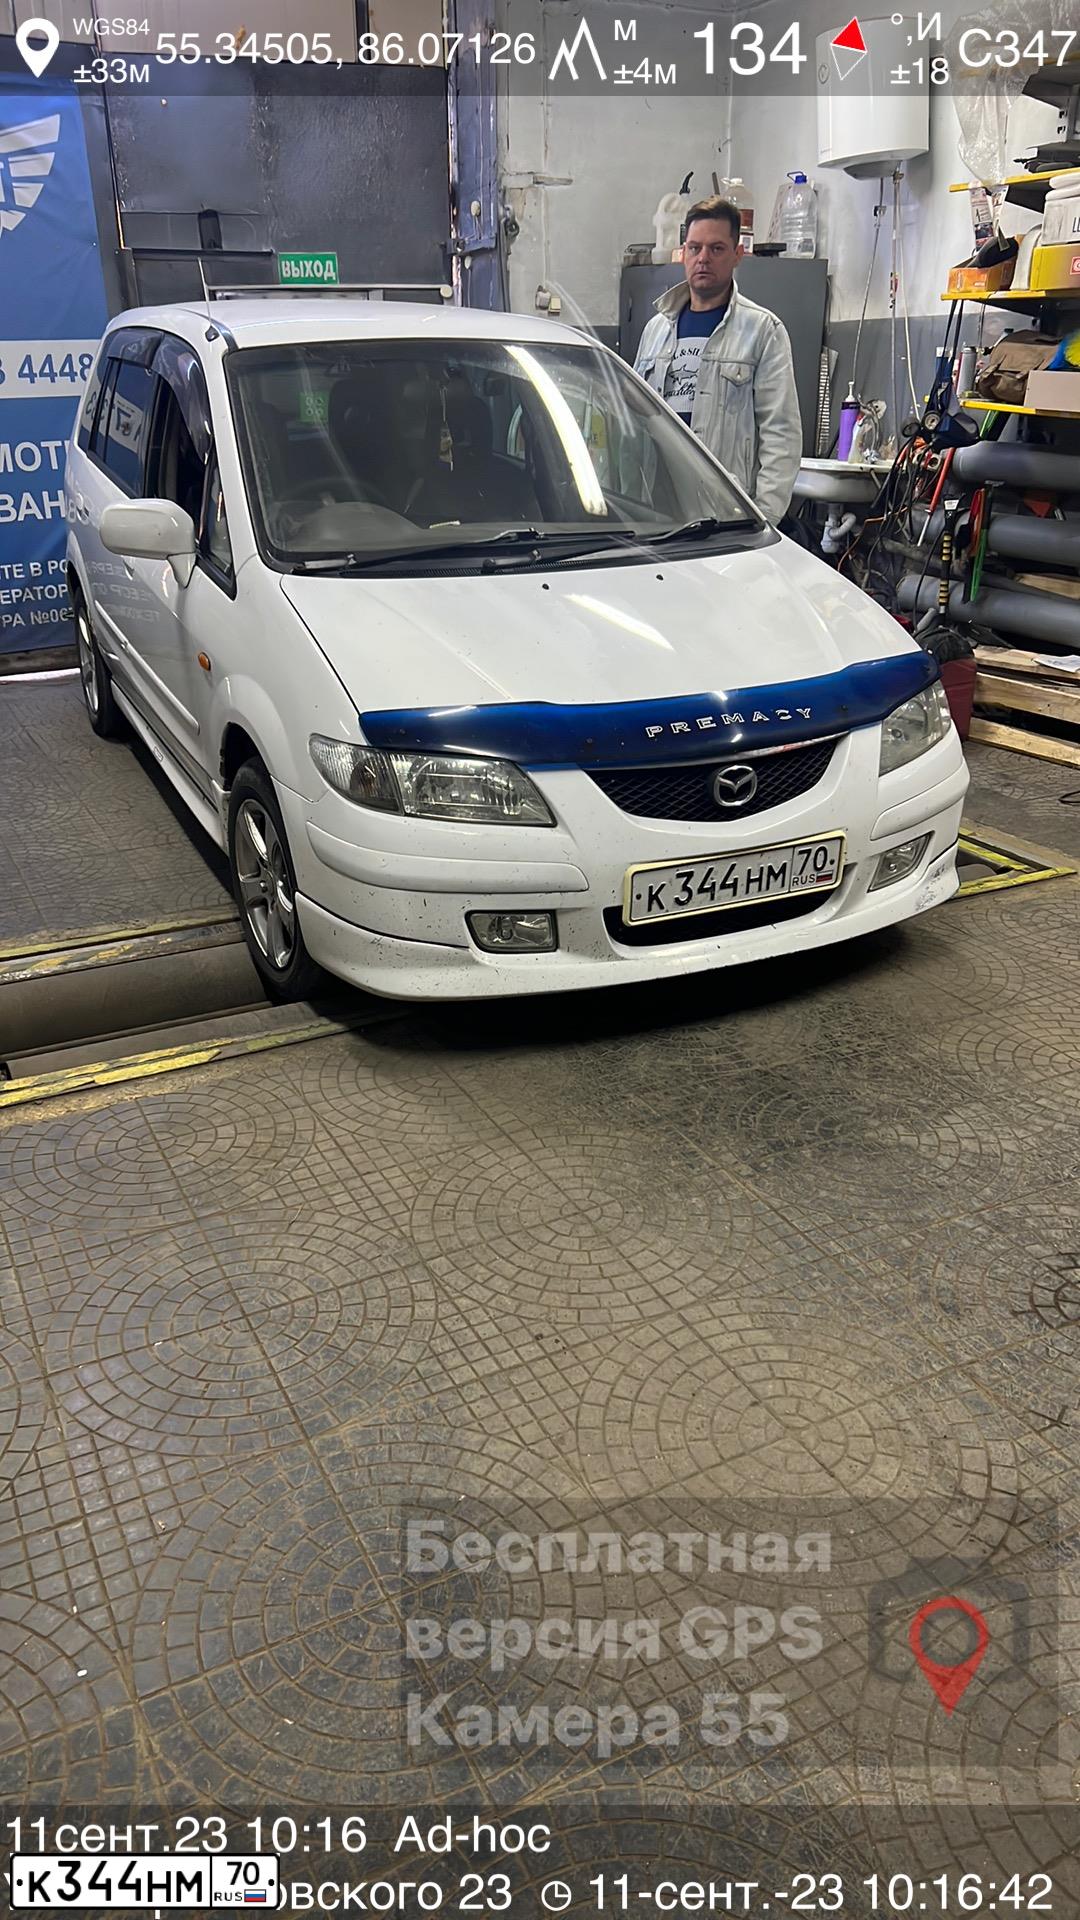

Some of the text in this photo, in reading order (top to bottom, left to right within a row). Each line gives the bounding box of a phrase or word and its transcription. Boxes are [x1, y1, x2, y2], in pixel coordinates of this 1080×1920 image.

[281, 260, 336, 280] ВЫХОД
[29, 561, 43, 578] В
[645, 707, 812, 738] PREMACY
[797, 846, 828, 876] 70
[792, 874, 815, 887] RUS
